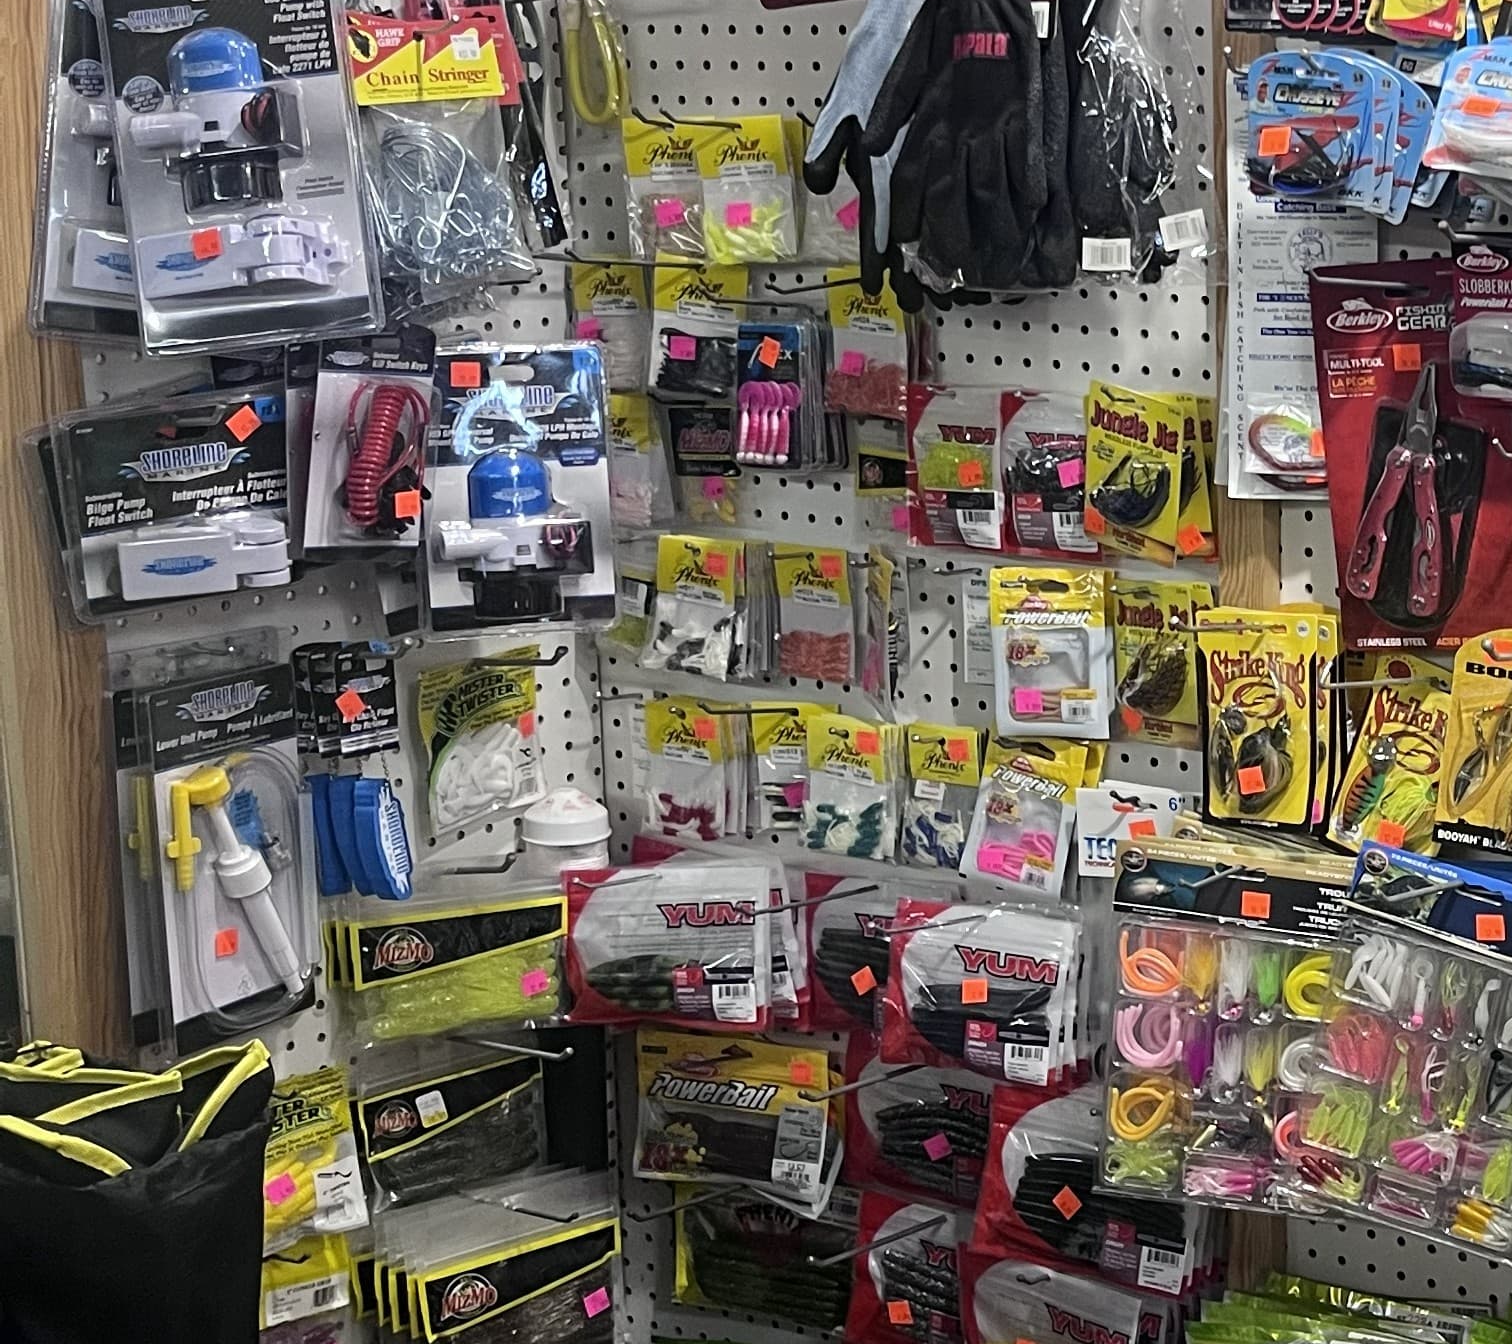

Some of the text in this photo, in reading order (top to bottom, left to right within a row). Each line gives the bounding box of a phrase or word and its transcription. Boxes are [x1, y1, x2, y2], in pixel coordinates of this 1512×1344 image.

[375, 28, 404, 39] HAWK
[376, 36, 400, 47] GRIP
[366, 65, 489, 86] Chain Stringer
[1332, 310, 1388, 329] Berkley
[1330, 358, 1384, 368] MULTI-TOOL
[1090, 400, 1149, 436] Jungle
[172, 484, 234, 503] Interrupteur
[86, 497, 145, 515] Bilge Pump
[88, 509, 153, 527] Float Switch
[1357, 637, 1427, 647] STAINLESS STEEL
[1169, 797, 1185, 811] 6"
[660, 902, 755, 926] YUM
[957, 945, 1059, 982] YUM
[650, 1071, 779, 1111] PowerBait
